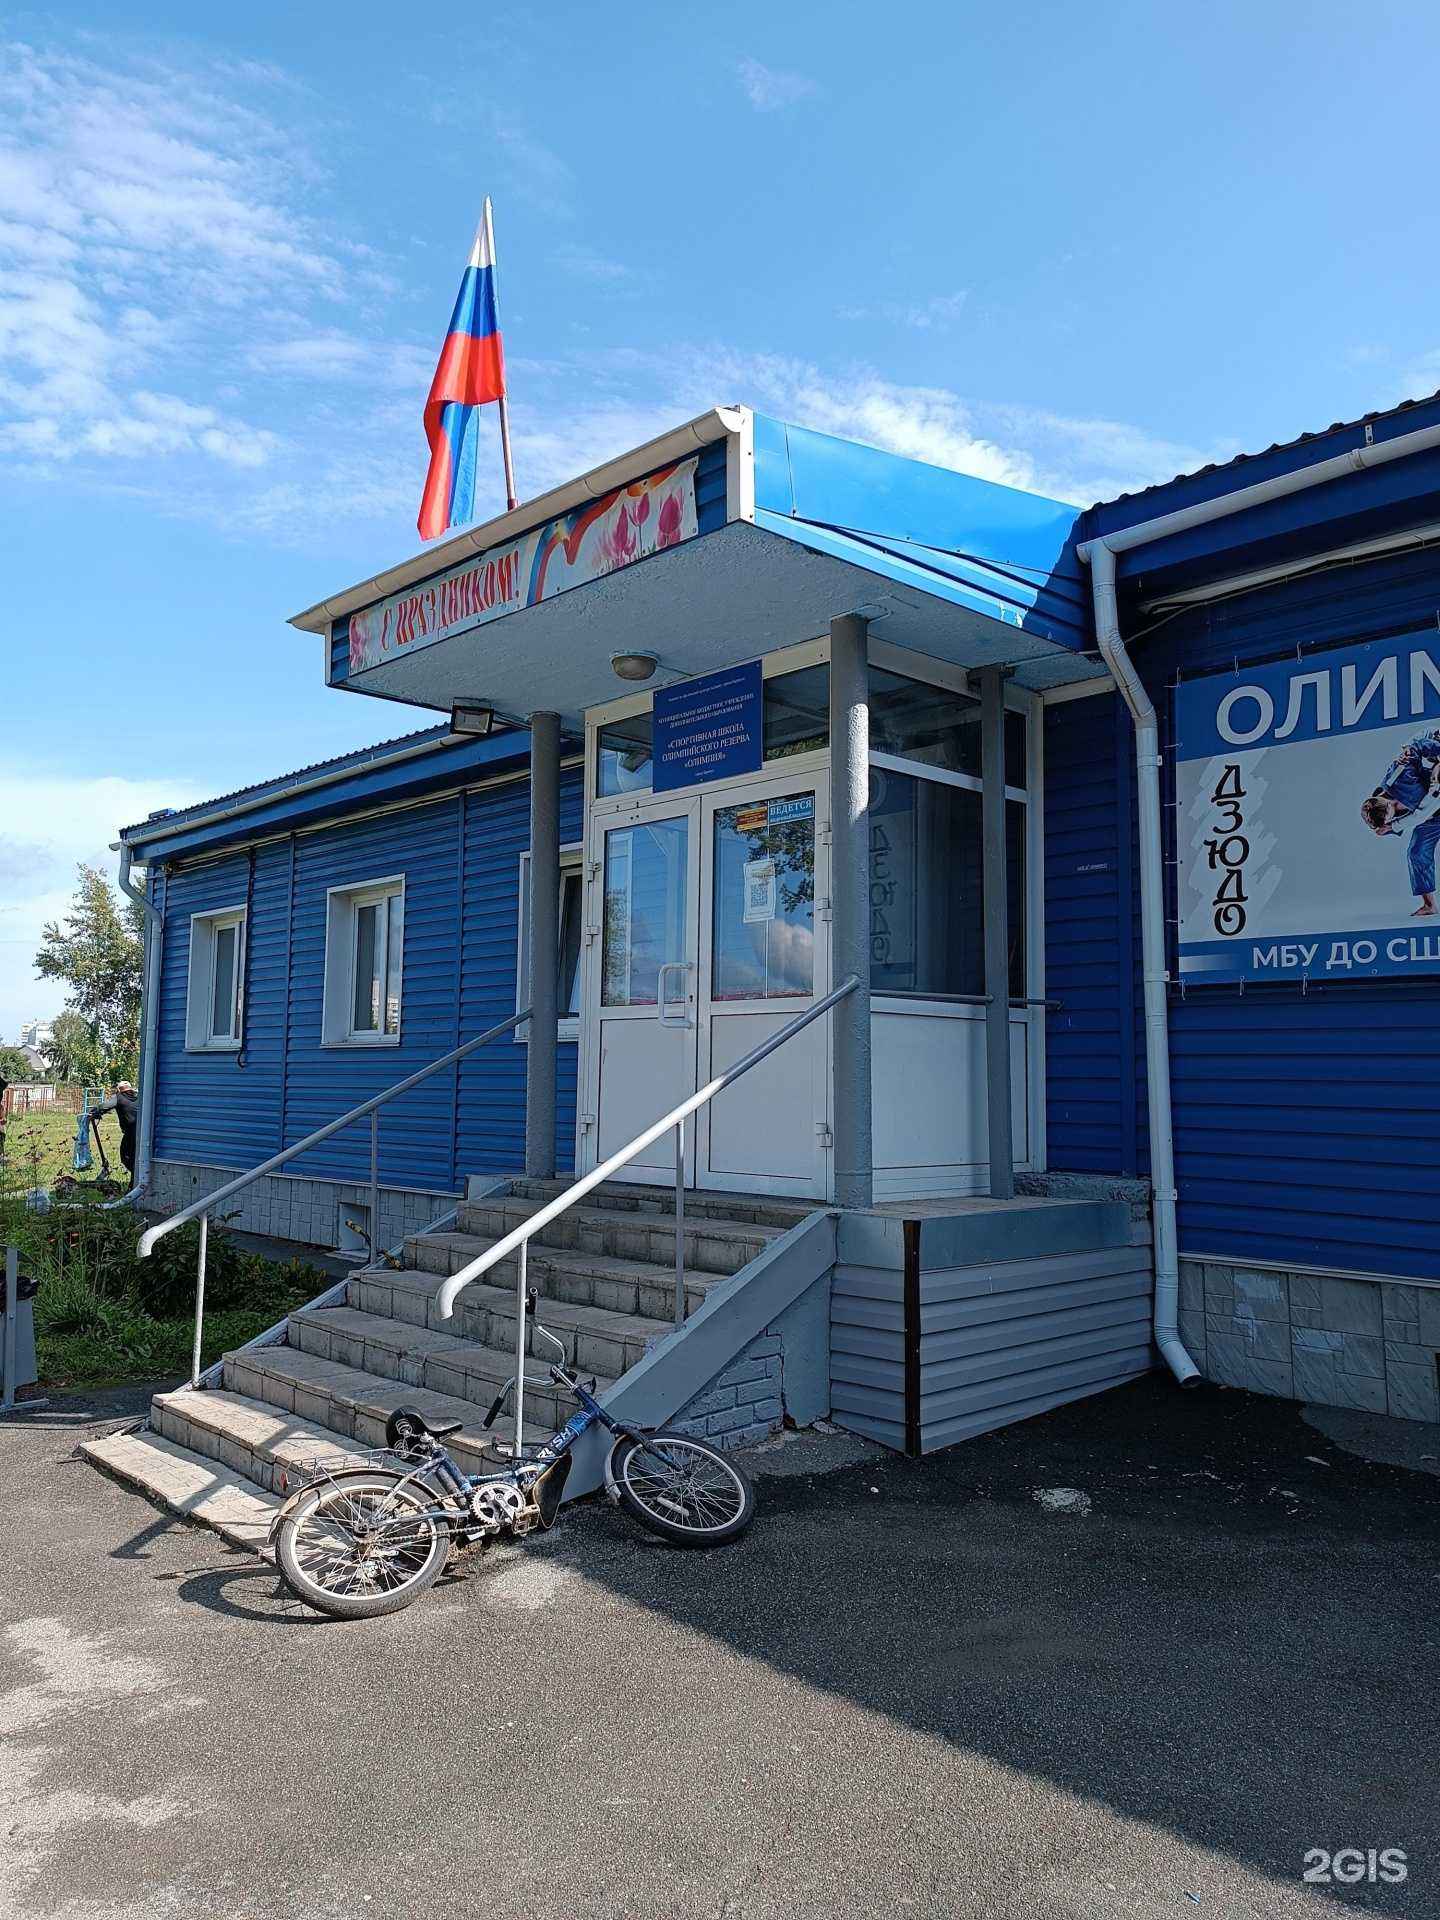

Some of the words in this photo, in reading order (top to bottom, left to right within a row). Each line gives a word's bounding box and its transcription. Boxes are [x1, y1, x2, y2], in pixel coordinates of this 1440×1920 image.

[381, 607, 392, 651] С
[396, 550, 520, 645] ПРАЗДНИКОМ!
[718, 723, 743, 735] ШКОЛА
[662, 740, 718, 761] ОЛИМПИЙСКОГО
[720, 733, 749, 747] РЕЗЕРВА
[770, 799, 812, 816] ВЕДЕТСЯ
[1203, 765, 1250, 937] ДЗЮДО
[1253, 944, 1319, 969] МБУ
[1326, 940, 1377, 970] ДО
